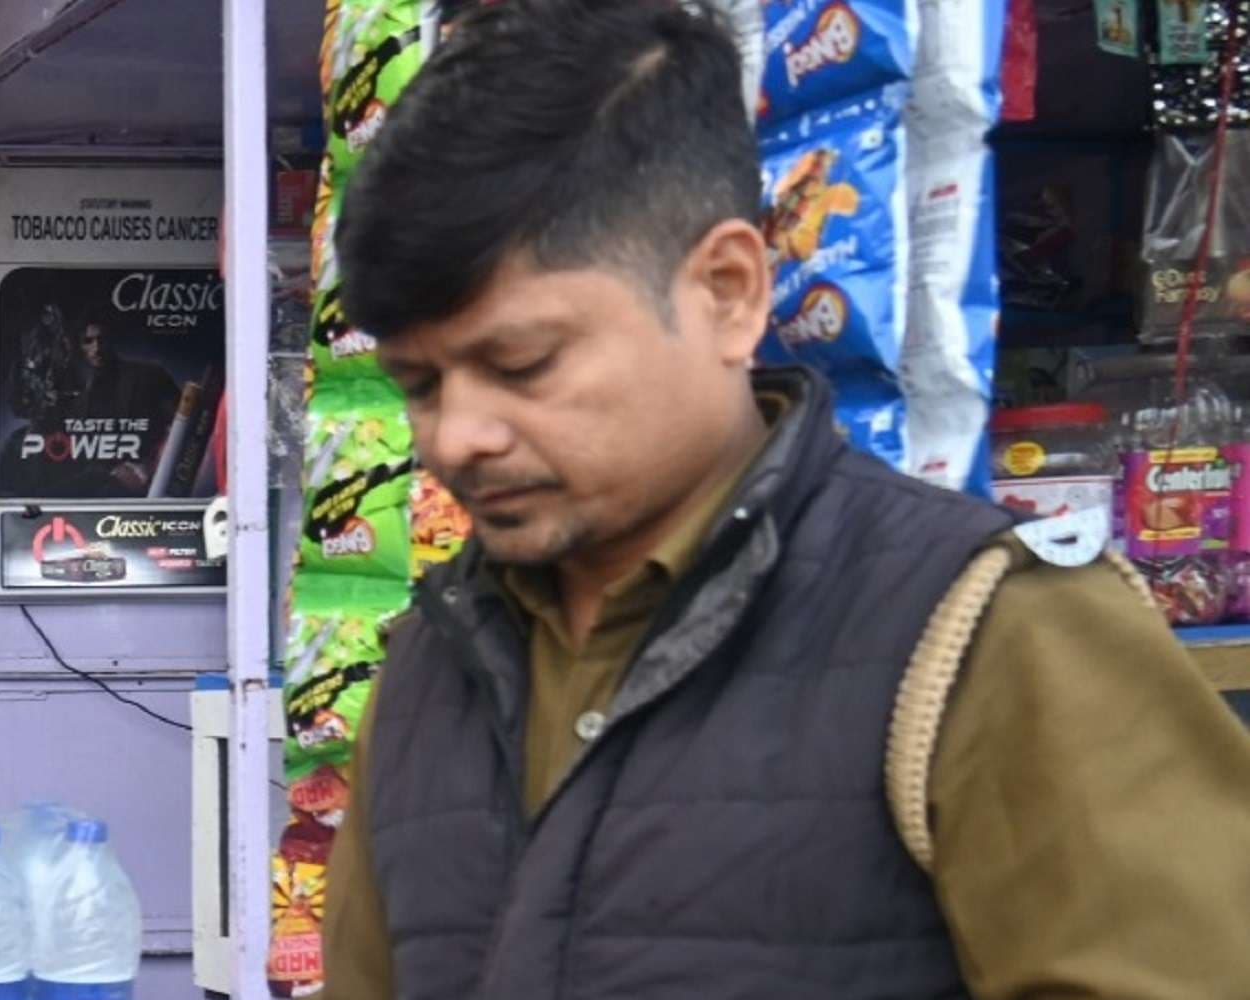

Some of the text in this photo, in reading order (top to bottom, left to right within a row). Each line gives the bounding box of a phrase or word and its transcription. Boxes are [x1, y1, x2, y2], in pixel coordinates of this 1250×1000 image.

[12, 215, 218, 241] TOBACCO CAUSES CANCER
[112, 272, 225, 312] Classic
[147, 314, 198, 327] ICON
[64, 418, 149, 433] TASTE THE
[21, 432, 141, 462] POWER
[96, 515, 199, 538] Classic ICON
[275, 951, 321, 974] MAD
